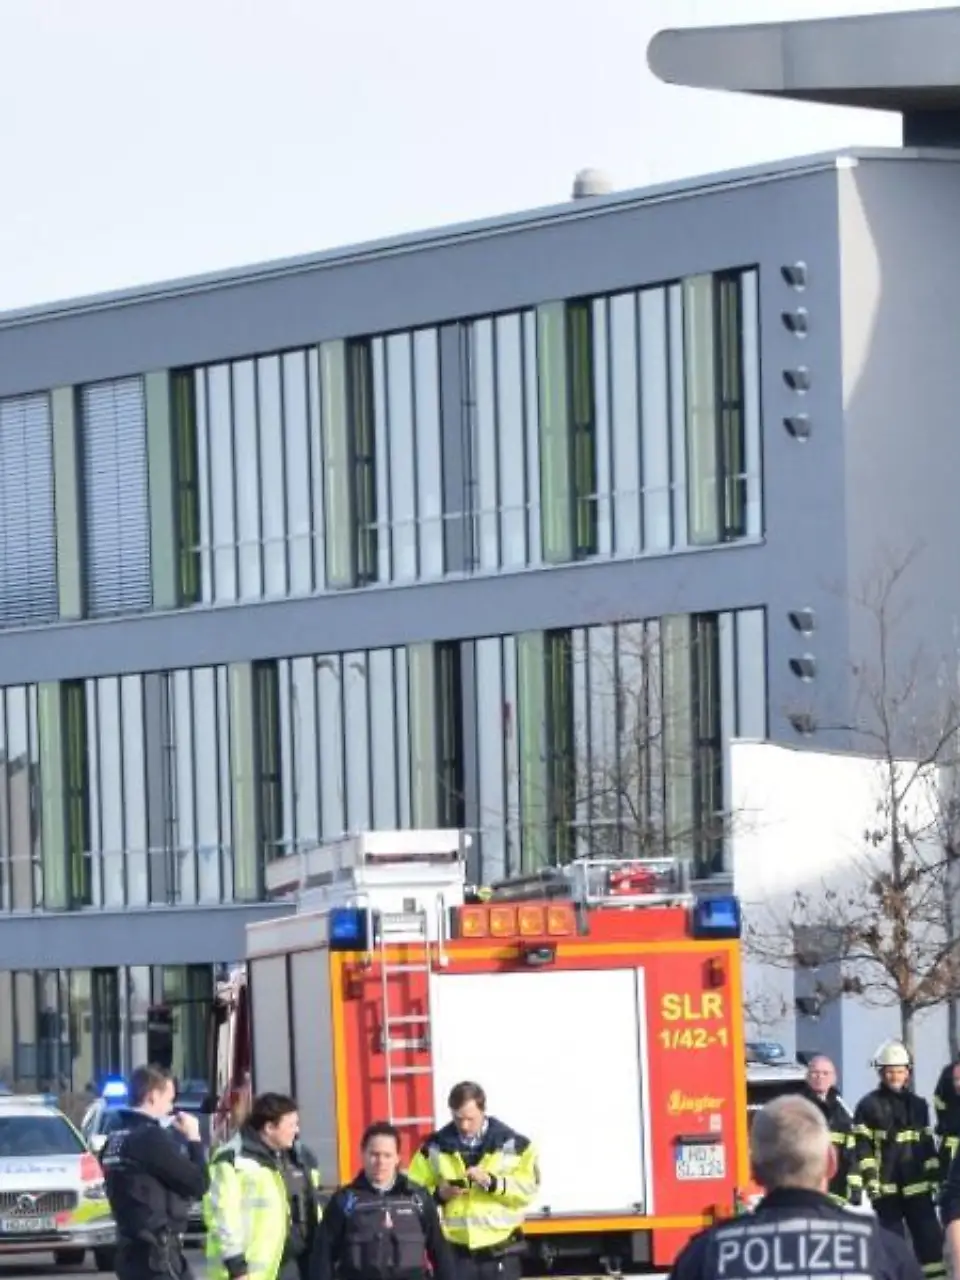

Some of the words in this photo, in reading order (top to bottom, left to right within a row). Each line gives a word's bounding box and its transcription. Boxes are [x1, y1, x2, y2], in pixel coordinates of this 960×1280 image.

[661, 993, 724, 1021] SLR
[659, 1027, 728, 1049] 1/42-1
[717, 1233, 869, 1274] POLIZEI
